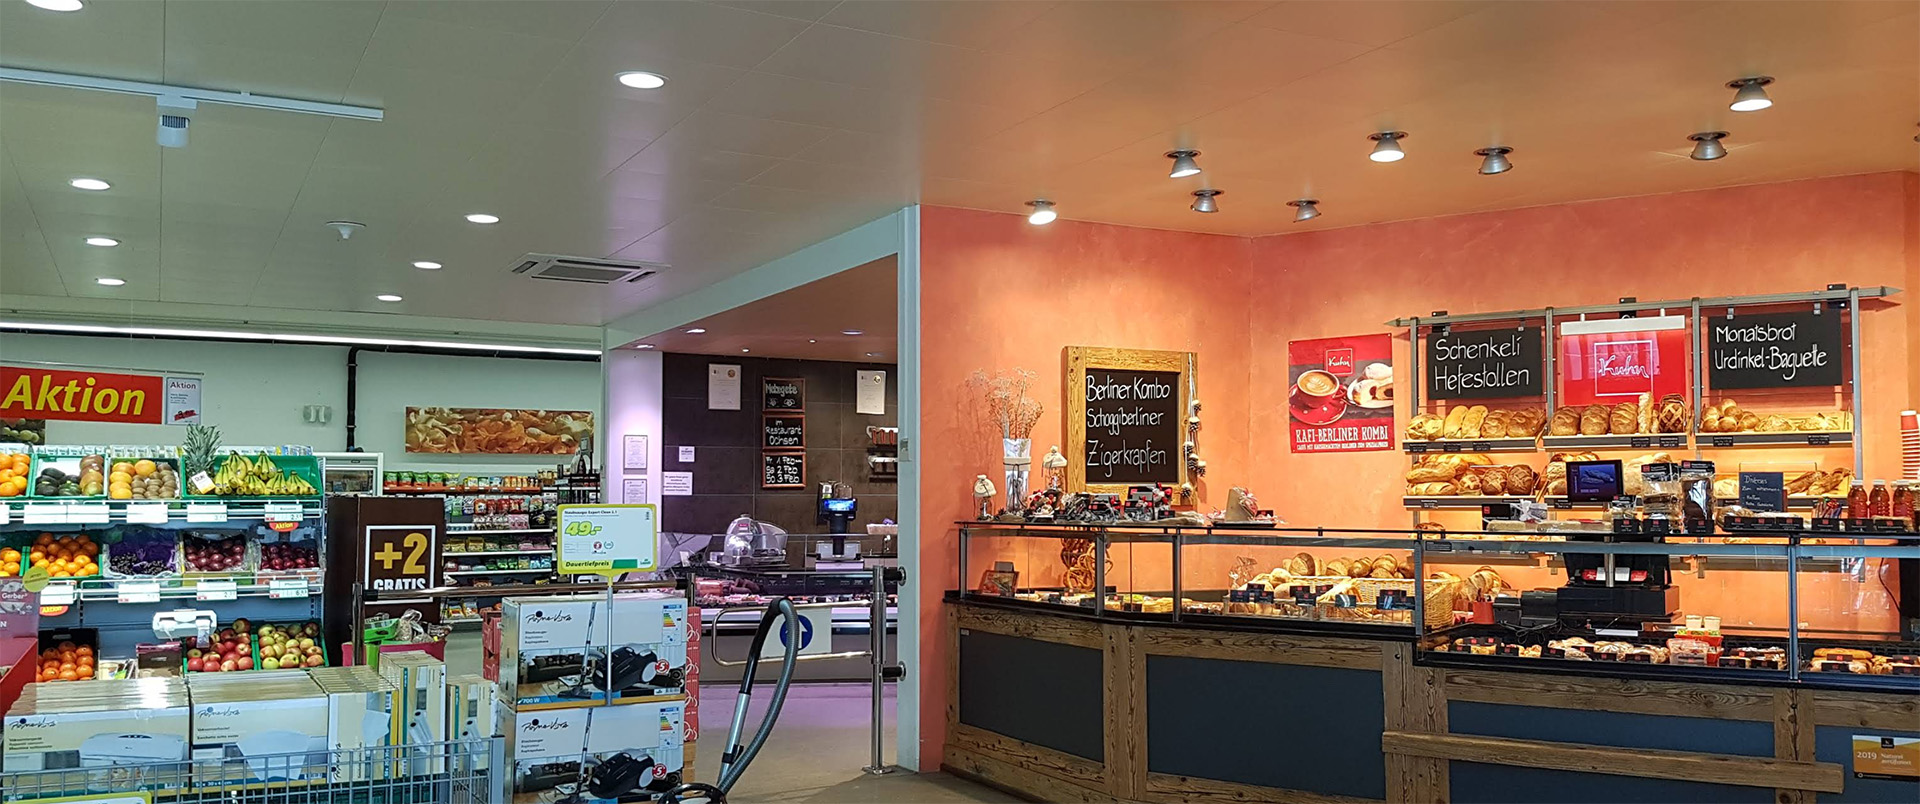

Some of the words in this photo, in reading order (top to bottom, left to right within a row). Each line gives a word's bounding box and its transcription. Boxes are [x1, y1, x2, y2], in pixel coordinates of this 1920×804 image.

[1715, 322, 1797, 344] Monatsbrot
[1435, 335, 1522, 361] Schenkeli
[1086, 375, 1132, 402] Berliner
[1434, 363, 1530, 394] Hefestollen
[0, 374, 146, 415] Aktion
[765, 425, 802, 435] Restaurant
[1087, 406, 1164, 436] Schoggiberliner
[769, 435, 799, 446] Ochsen
[1295, 427, 1359, 442] KAFI-BERLINER
[1361, 425, 1389, 440] KOMBI
[776, 465, 783, 474] 2
[1087, 439, 1167, 478] Zigerkrapfen
[776, 474, 783, 483] 3
[564, 520, 603, 536] 49.-
[374, 532, 428, 575] +2
[1857, 751, 1877, 760] 2019
